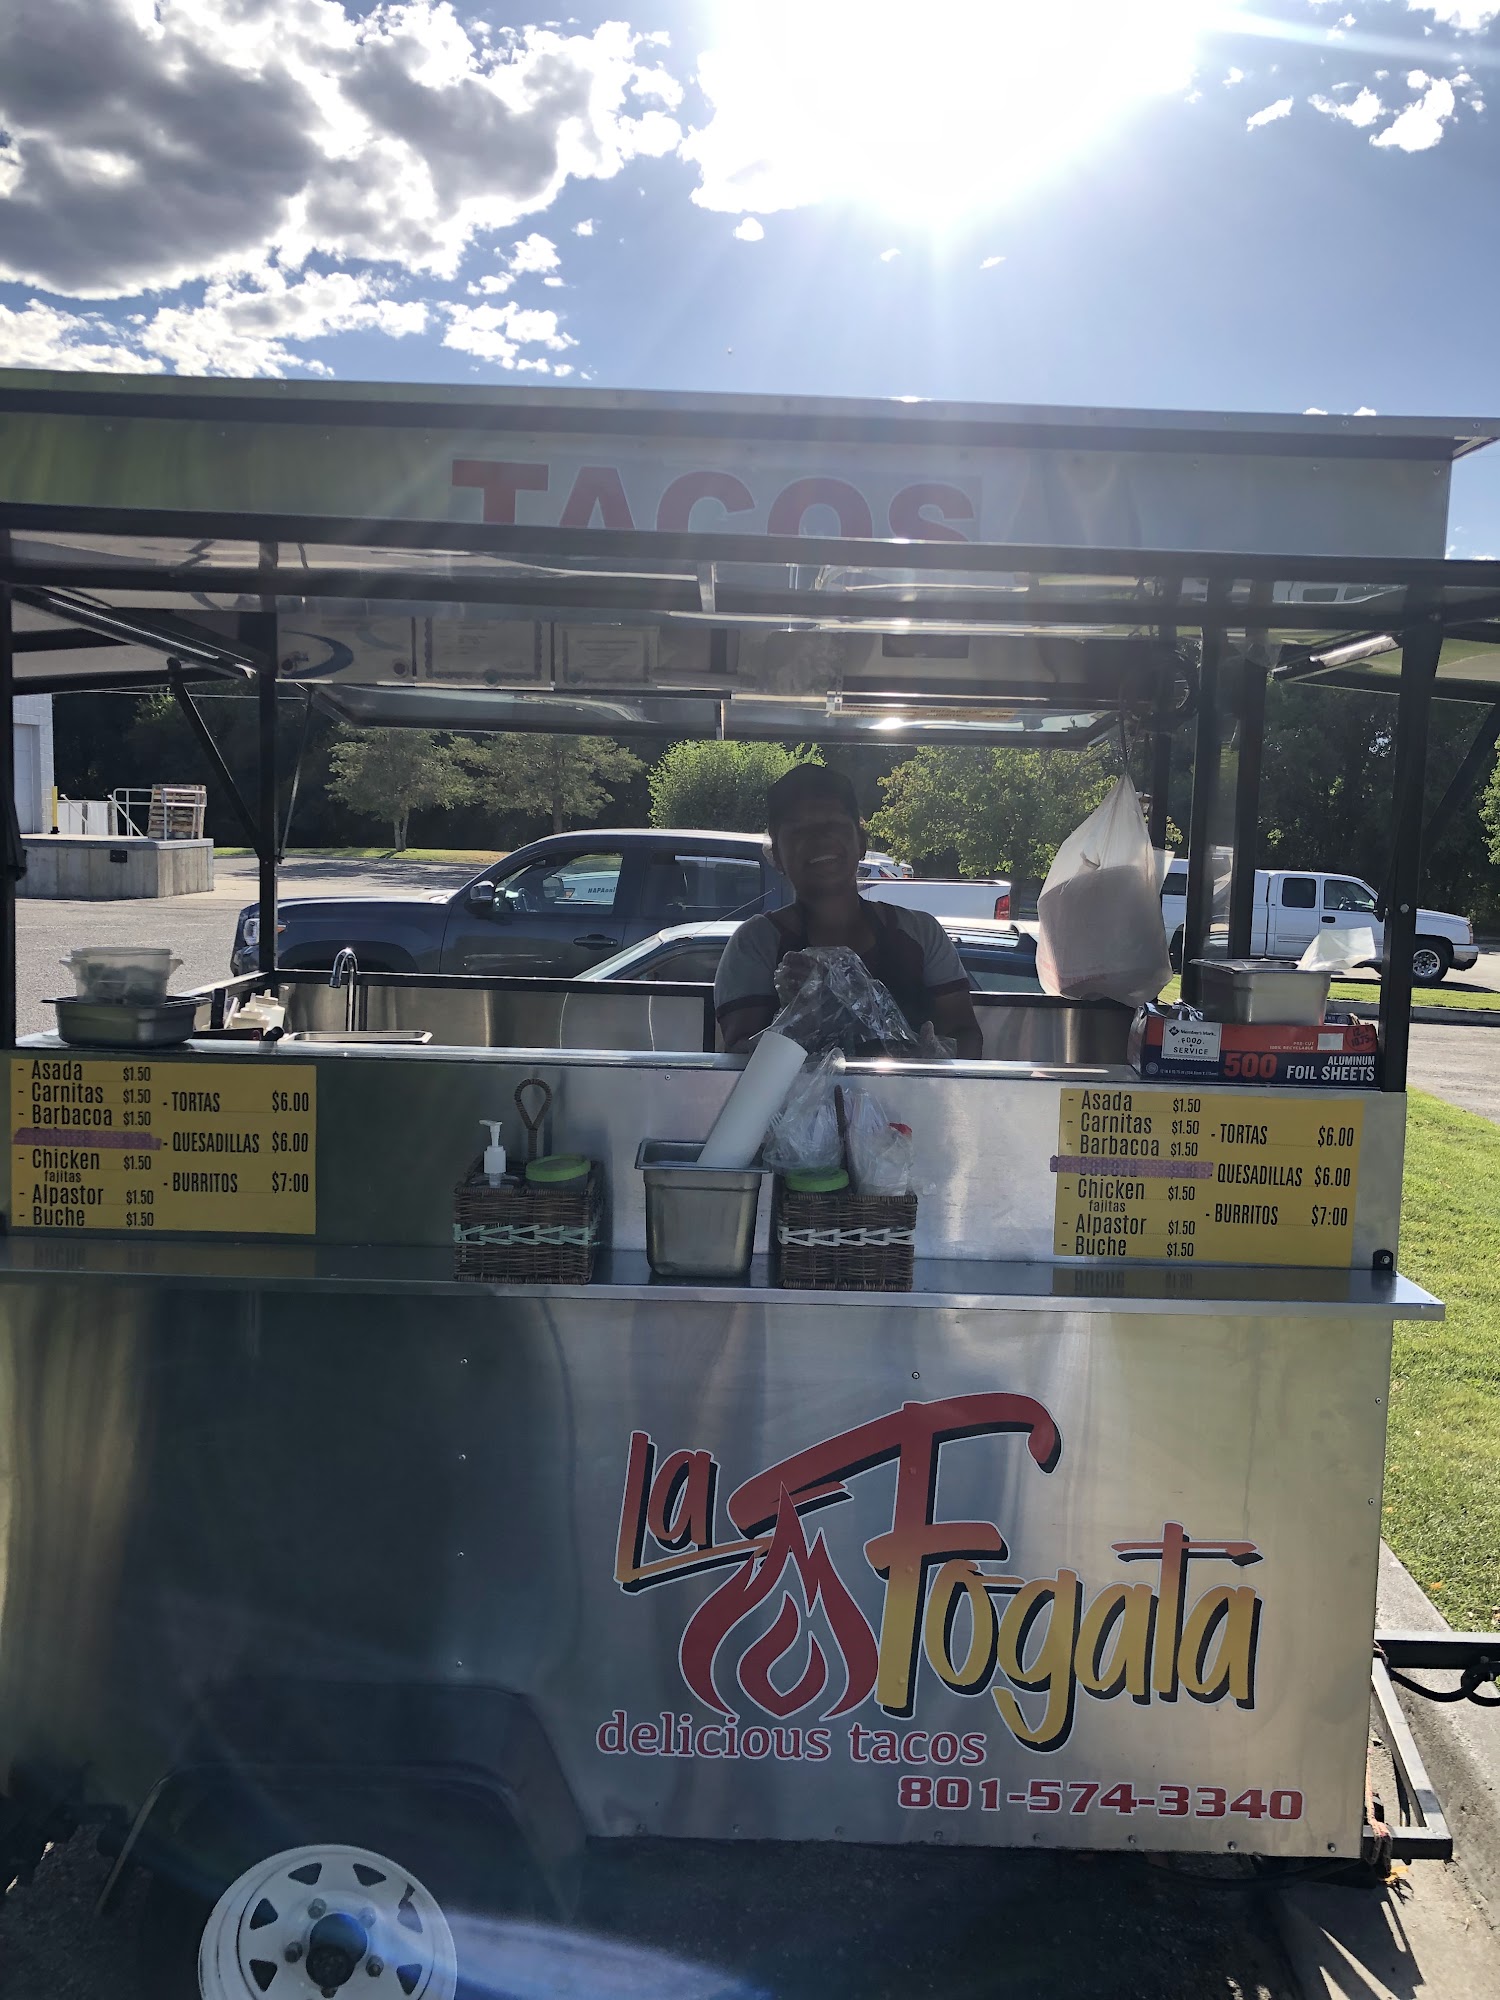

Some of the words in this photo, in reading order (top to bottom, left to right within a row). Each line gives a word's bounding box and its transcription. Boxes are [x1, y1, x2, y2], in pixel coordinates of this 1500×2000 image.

[452, 459, 975, 541] TACOS
[1173, 1046, 1208, 1055] SERVICE
[1328, 1056, 1375, 1066] ALUMINUM
[32, 1060, 82, 1081] Asada
[123, 1067, 151, 1082] $1.50
[1224, 1053, 1277, 1078] 500
[1286, 1065, 1317, 1080] FOIL
[1321, 1066, 1375, 1081] SHEETS
[32, 1082, 103, 1103] Carnitas
[123, 1089, 151, 1104] $1.50
[172, 1091, 220, 1112] TORTAS
[272, 1091, 309, 1113] $6.00
[1081, 1090, 1133, 1111] Asada
[1173, 1098, 1201, 1113] $1.50
[32, 1104, 112, 1126] Barbacoa
[123, 1111, 151, 1126] $1.50
[1081, 1112, 1152, 1134] Carnitas
[1171, 1120, 1200, 1136] $1.50
[173, 1132, 260, 1153] QUESADILLAS
[272, 1132, 309, 1154] $6.00
[1220, 1123, 1268, 1145] TORTAS
[1317, 1127, 1354, 1147] $6.00
[1080, 1135, 1159, 1157] Barbacoa
[1170, 1142, 1198, 1158] $1.50
[32, 1149, 100, 1170] Chicken
[124, 1155, 151, 1171] $1.50
[44, 1170, 82, 1183] fajitas
[172, 1172, 238, 1193] BURRITOS
[1217, 1163, 1303, 1187] QUESADILLAS
[1314, 1167, 1351, 1187] $6.00
[33, 1184, 103, 1207] Alpastor
[126, 1190, 154, 1205] $1.50
[1078, 1179, 1145, 1200] Chicken
[1168, 1186, 1195, 1201] $1.50
[33, 1206, 85, 1226] Buche
[126, 1212, 154, 1227] $1.50
[1089, 1200, 1126, 1213] fajitas
[1215, 1203, 1278, 1226] BURRITOS
[1075, 1214, 1147, 1236] Alpastor
[1168, 1220, 1195, 1236] $1.50
[1075, 1236, 1127, 1256] Buche
[1166, 1242, 1194, 1257] $1.50
[727, 1392, 1263, 1752] Fogata
[596, 1710, 832, 1761] delicious
[848, 1721, 986, 1766] tacos
[897, 1775, 1305, 1821] 801-574-3340
